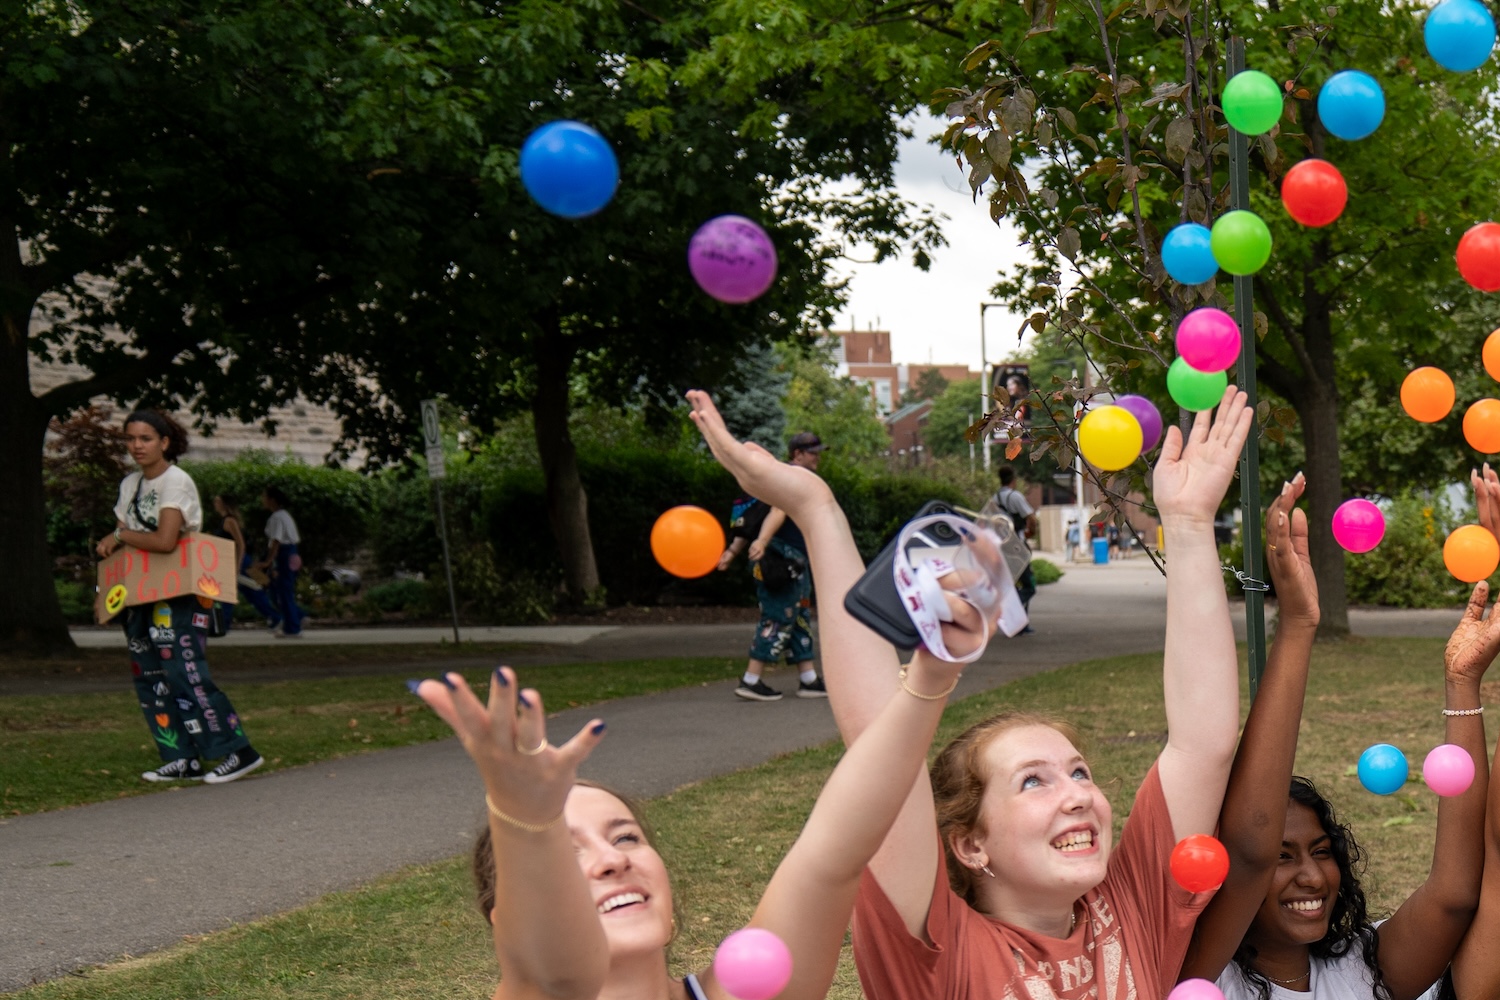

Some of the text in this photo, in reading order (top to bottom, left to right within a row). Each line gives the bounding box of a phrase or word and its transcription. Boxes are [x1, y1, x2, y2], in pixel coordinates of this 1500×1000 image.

[105, 537, 219, 588] HOT TO
[137, 570, 181, 602] GO
